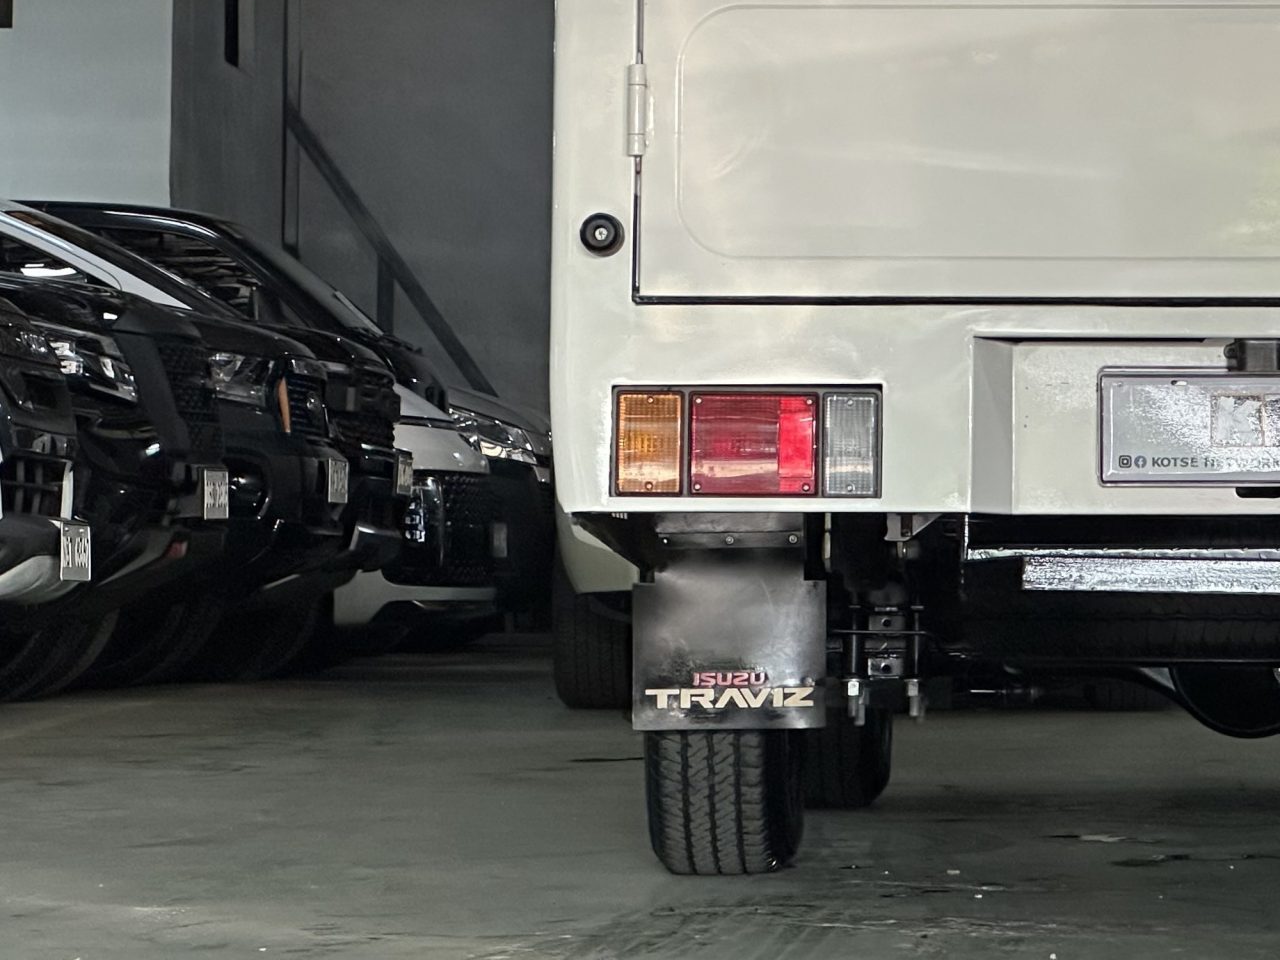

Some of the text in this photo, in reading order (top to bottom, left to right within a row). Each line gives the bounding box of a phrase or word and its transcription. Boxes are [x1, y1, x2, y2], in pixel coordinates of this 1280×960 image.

[1152, 456, 1198, 468] KOTSE
[692, 672, 766, 686] ISUZU
[645, 688, 814, 709] TRAVIZ
